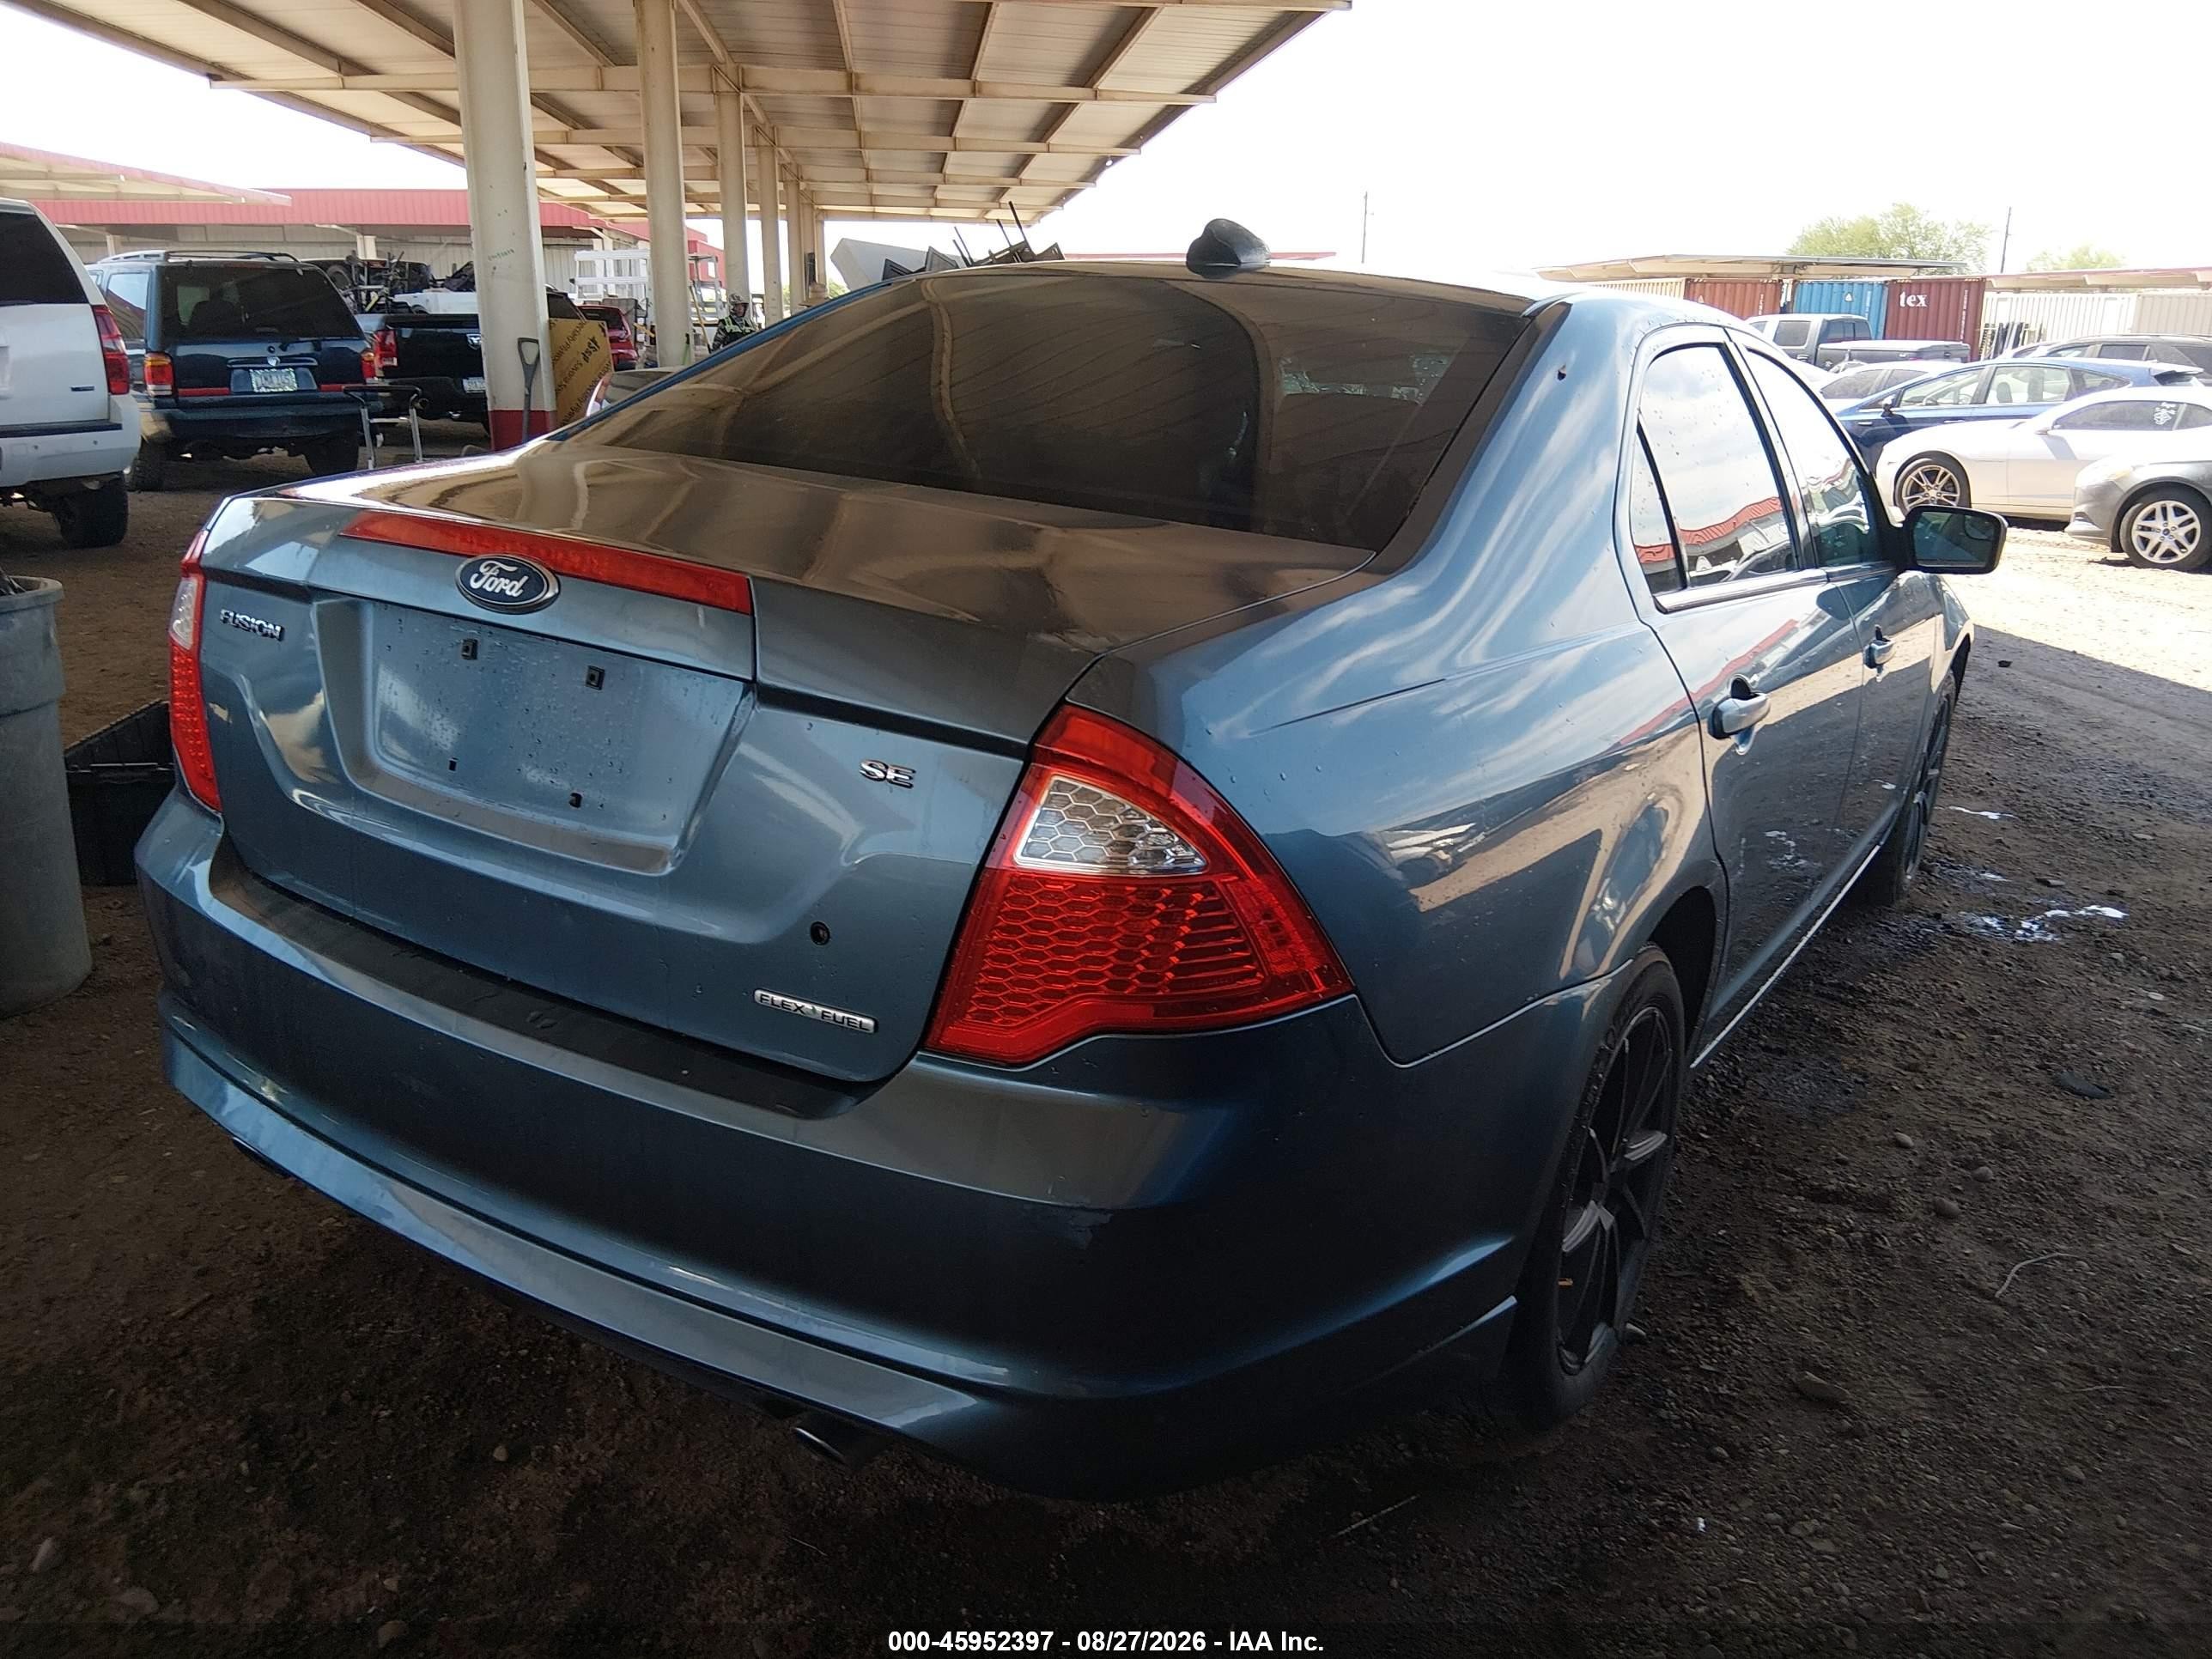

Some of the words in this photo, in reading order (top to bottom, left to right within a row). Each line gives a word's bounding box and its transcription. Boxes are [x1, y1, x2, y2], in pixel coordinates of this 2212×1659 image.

[1899, 291, 1928, 307] tex
[470, 560, 529, 598] Ford
[220, 609, 283, 641] FUSION
[859, 759, 916, 789] SE
[759, 993, 805, 1015] FLEX
[820, 1010, 871, 1032] FUEL
